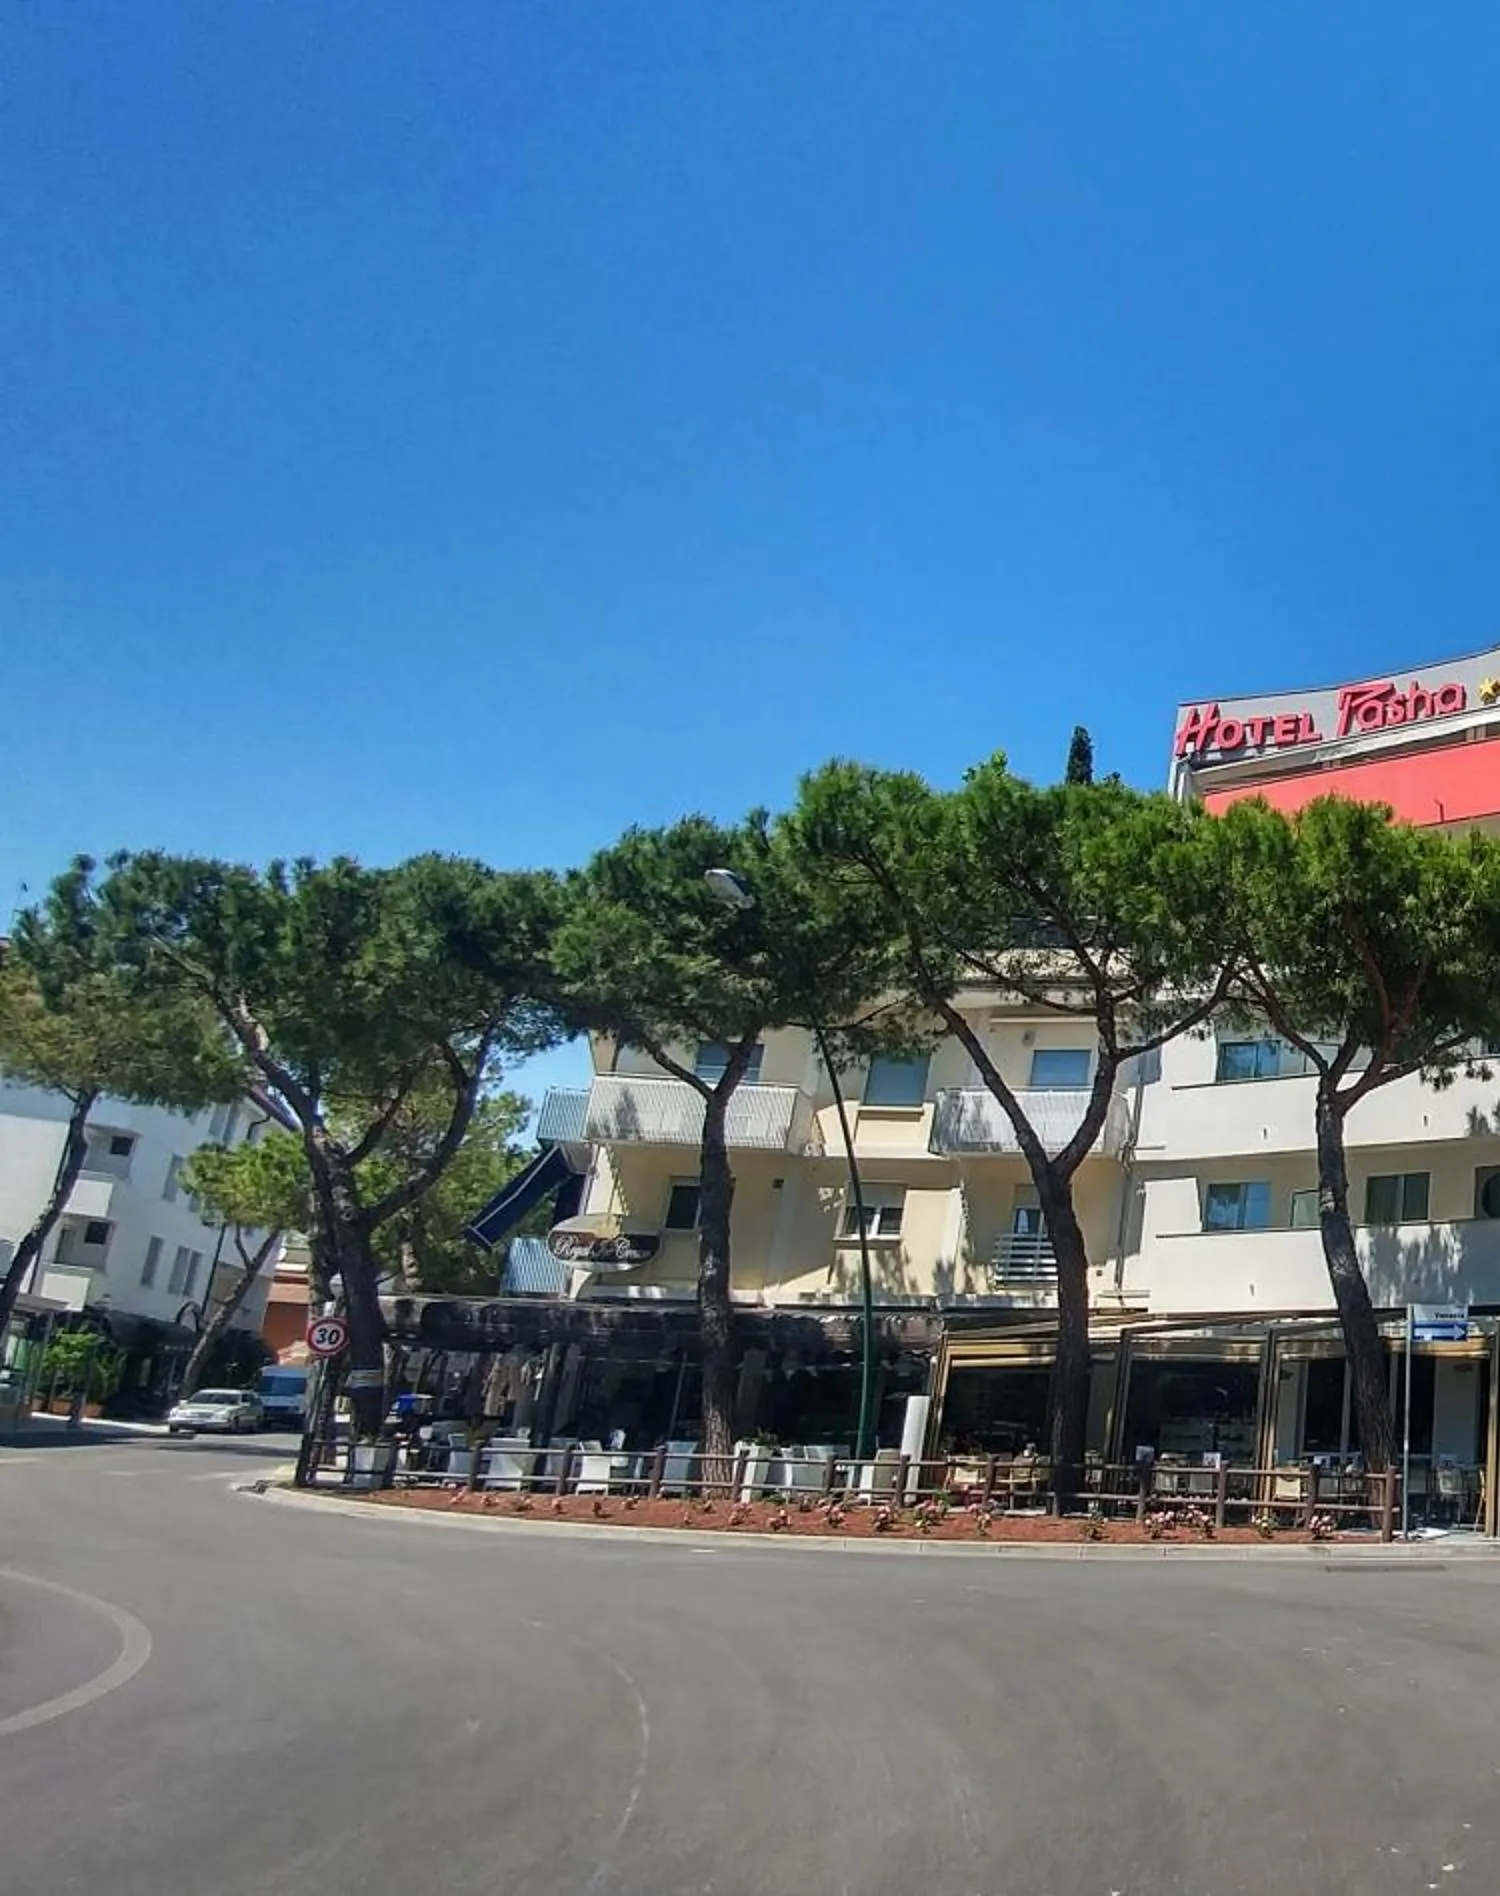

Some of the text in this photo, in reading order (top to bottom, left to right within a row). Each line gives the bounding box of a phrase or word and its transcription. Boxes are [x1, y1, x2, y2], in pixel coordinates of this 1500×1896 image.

[1174, 680, 1466, 757] HOTEL Pasha
[316, 1327, 341, 1345] 30
